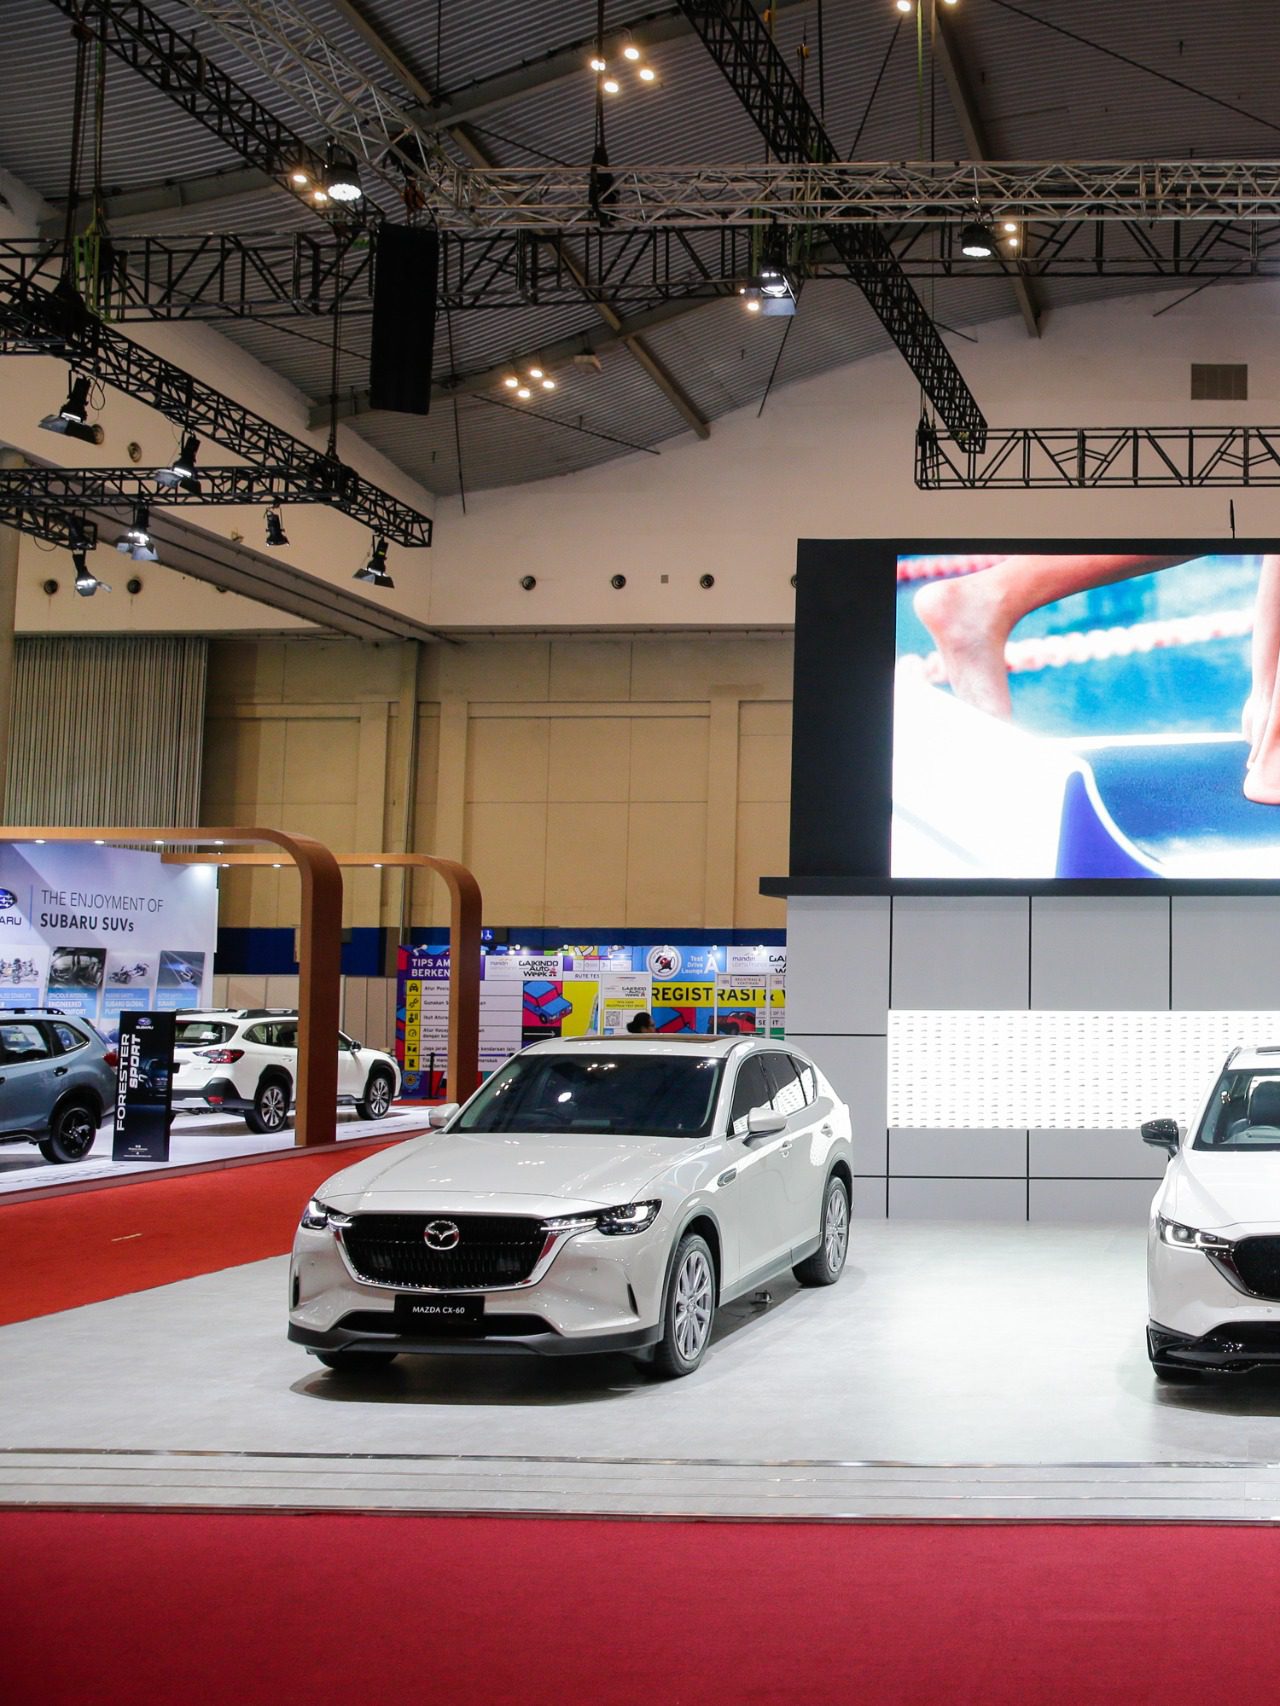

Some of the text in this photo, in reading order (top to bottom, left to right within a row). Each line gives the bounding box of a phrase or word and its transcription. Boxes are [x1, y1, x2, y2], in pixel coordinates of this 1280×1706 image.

[42, 889, 164, 912] THE ENJOYMENT OF
[40, 913, 135, 932] SUBARU SUVs
[412, 958, 434, 967] TIPS
[129, 1034, 141, 1088] SPORT
[116, 1033, 130, 1131] FORESTER
